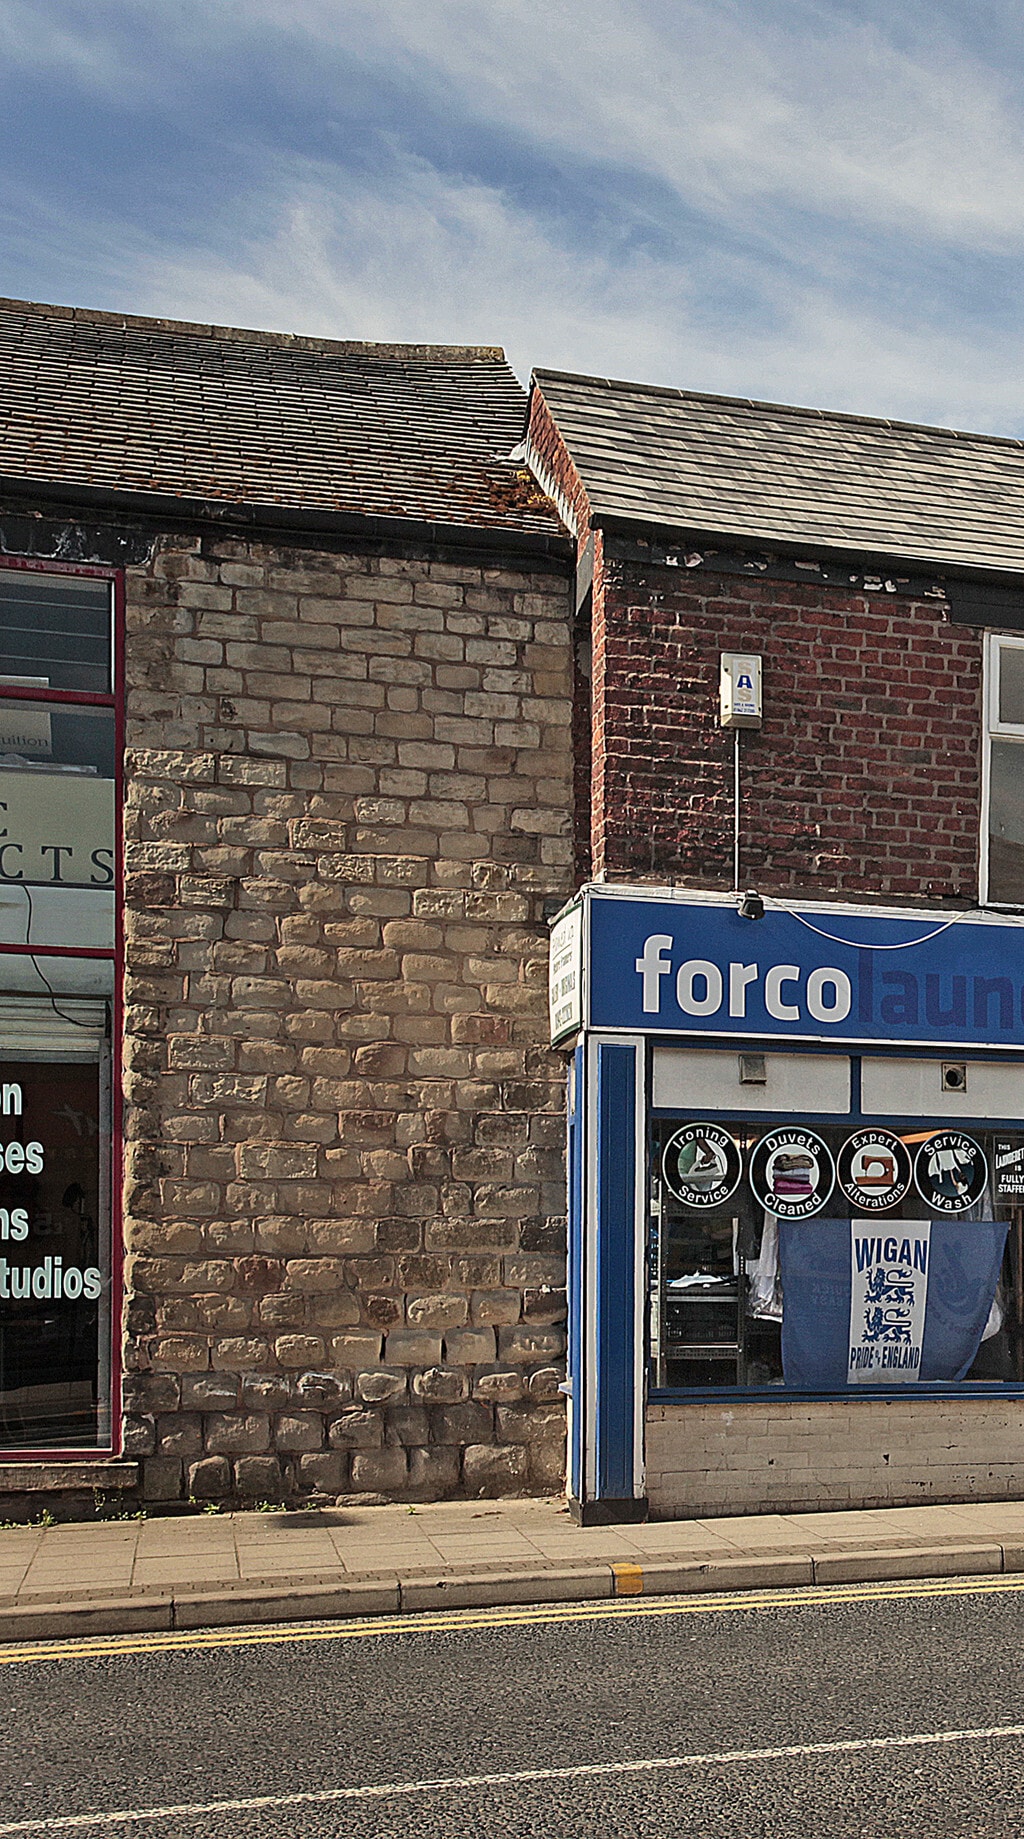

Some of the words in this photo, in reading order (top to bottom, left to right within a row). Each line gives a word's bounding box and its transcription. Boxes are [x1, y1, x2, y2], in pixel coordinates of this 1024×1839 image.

[0, 843, 114, 884] CTS
[635, 934, 852, 1023] forco
[0, 1083, 22, 1115] n
[672, 1126, 729, 1150] Ironing
[765, 1133, 821, 1155] Duvets
[851, 1133, 898, 1151] Expert
[924, 1135, 977, 1157] Service
[0, 1141, 44, 1174] es
[1001, 1174, 1024, 1183] FULLY
[678, 1185, 729, 1204] Service
[764, 1192, 822, 1216] Cleaned
[844, 1182, 905, 1208] Alterations
[931, 1191, 973, 1209] Wash
[854, 1237, 928, 1275] WIGAN
[850, 1346, 875, 1369] PRIDE
[881, 1346, 920, 1369] ENGLAND
